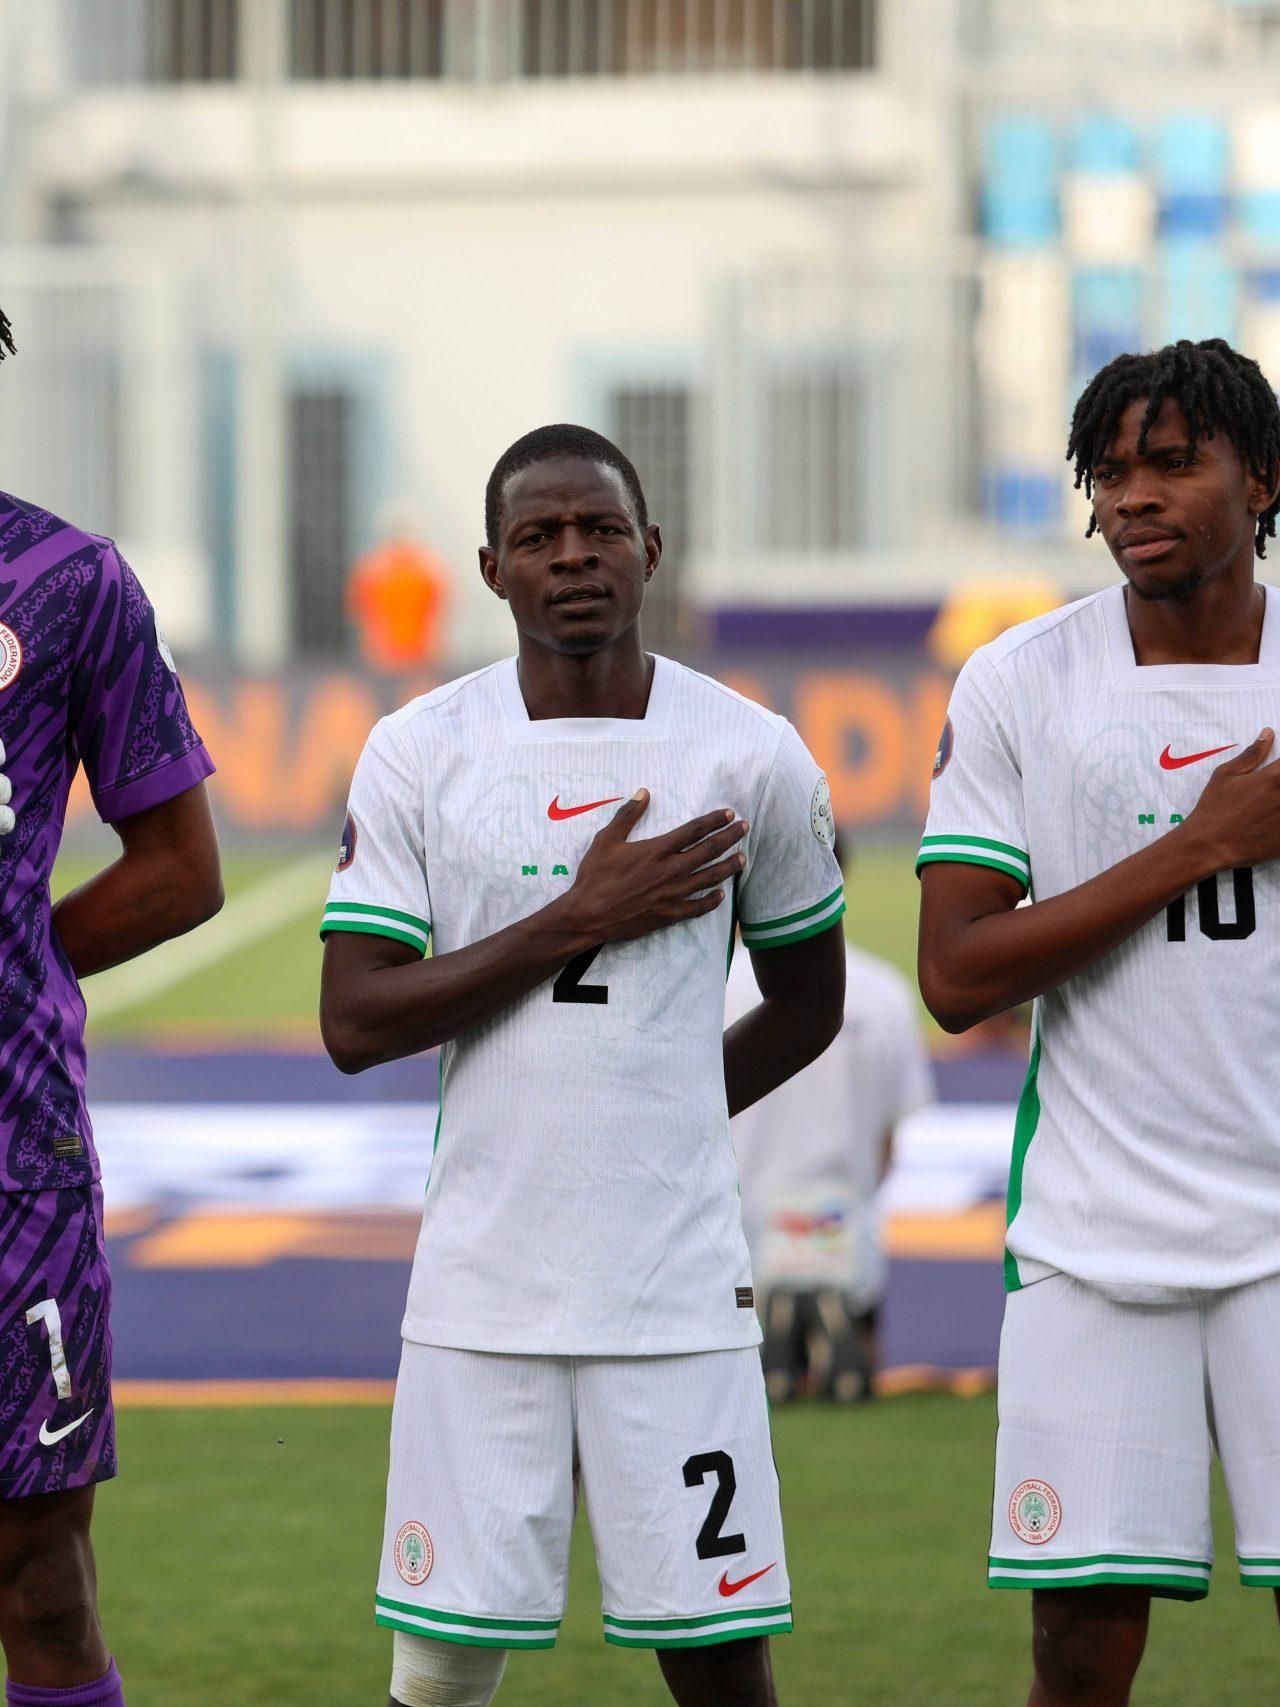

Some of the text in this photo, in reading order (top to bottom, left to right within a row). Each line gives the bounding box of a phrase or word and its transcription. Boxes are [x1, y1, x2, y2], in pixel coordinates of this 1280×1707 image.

[0, 629, 18, 682] FEDERATION
[25, 1298, 72, 1400] 1
[682, 1450, 746, 1560] 2
[1014, 1483, 1042, 1501] FOOTBALL
[1042, 1487, 1058, 1532] FEDERATION
